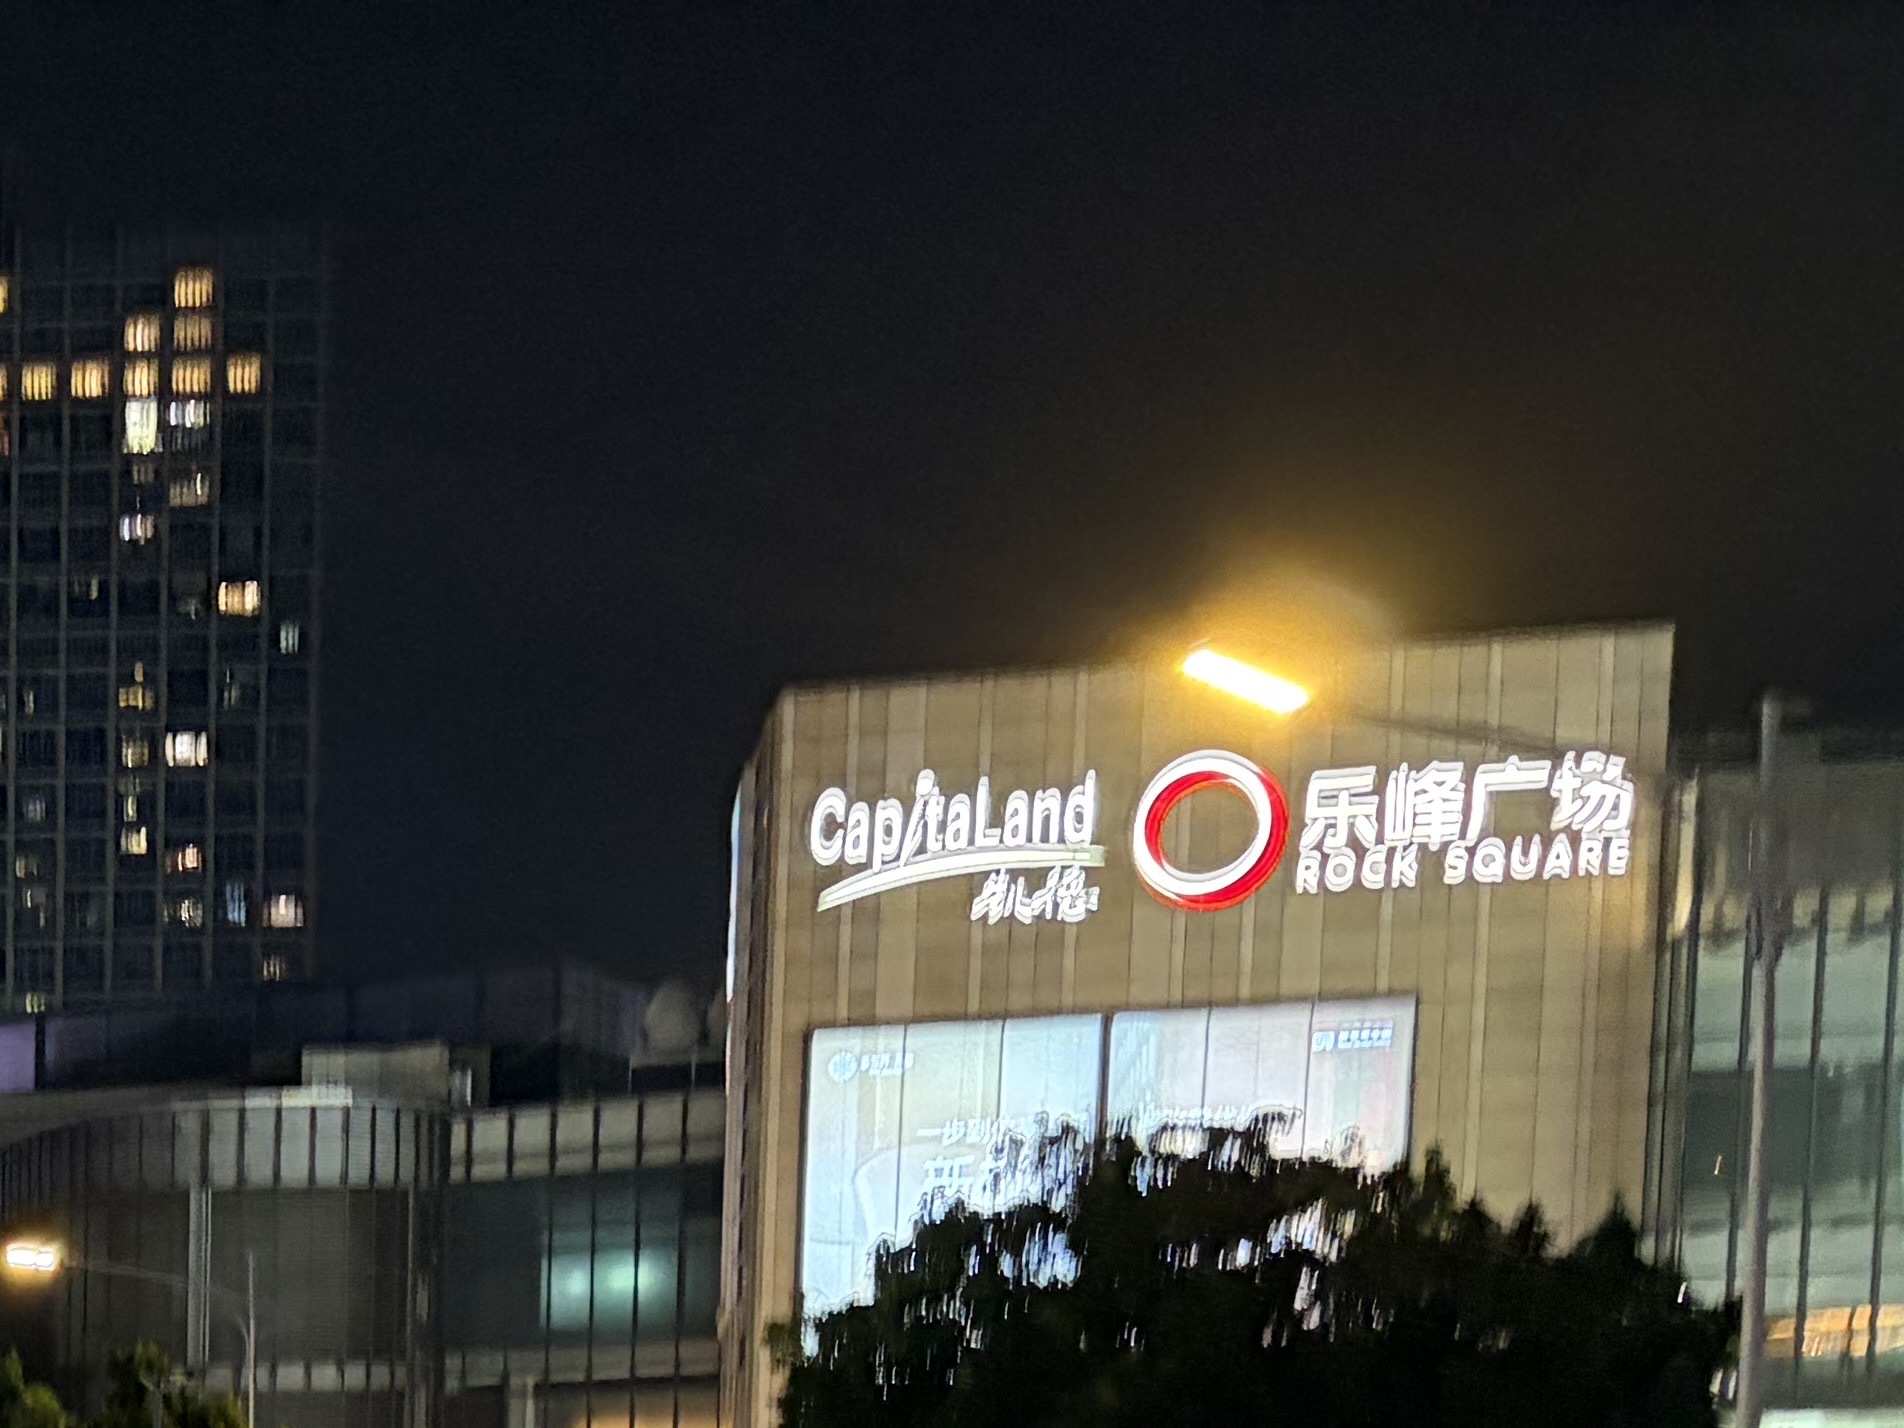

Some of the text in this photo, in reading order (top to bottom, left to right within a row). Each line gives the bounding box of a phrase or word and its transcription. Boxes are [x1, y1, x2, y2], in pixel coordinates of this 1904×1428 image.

[810, 768, 1097, 874] CapitaLand
[1299, 750, 1636, 850] 乐峰广场
[1295, 829, 1631, 894] ROCK SQUARE
